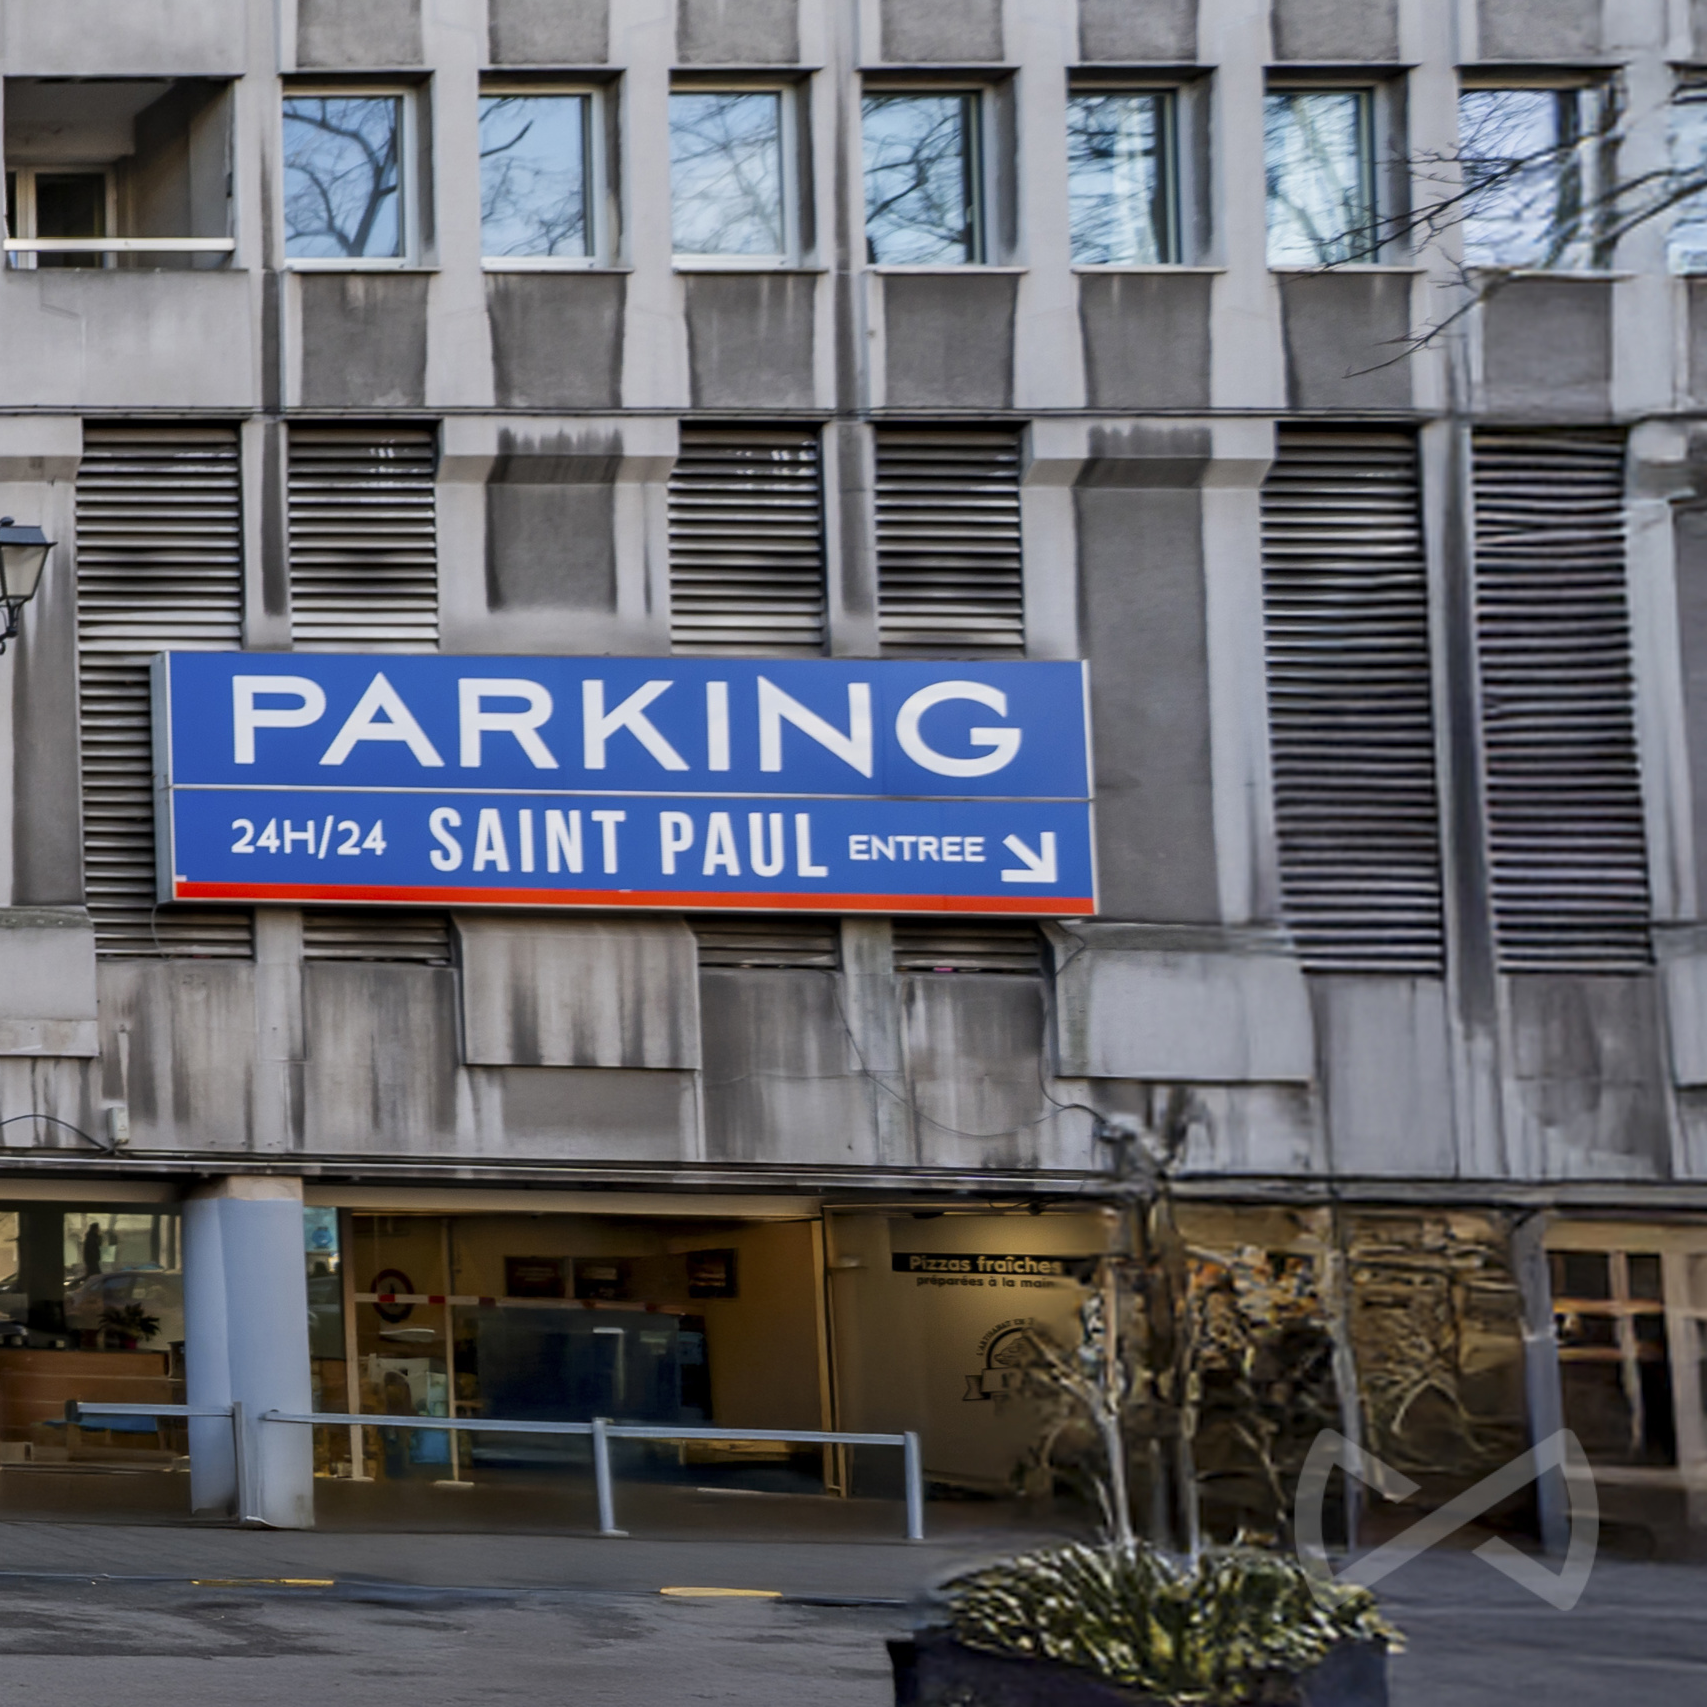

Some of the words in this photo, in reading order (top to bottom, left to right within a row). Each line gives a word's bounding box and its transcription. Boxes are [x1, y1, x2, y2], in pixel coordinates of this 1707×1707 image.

[231, 671, 1023, 779] PARKING
[229, 817, 388, 860] 24H/24
[429, 805, 626, 875] SAINT
[660, 809, 829, 879] PAUL
[848, 833, 987, 864] ENTREE
[909, 1254, 972, 1271] Pizzas
[976, 1255, 1063, 1274] fraîches
[916, 1275, 984, 1288] préparées
[988, 1276, 997, 1287] à
[1002, 1277, 1016, 1288] la
[1021, 1278, 1055, 1288] main
